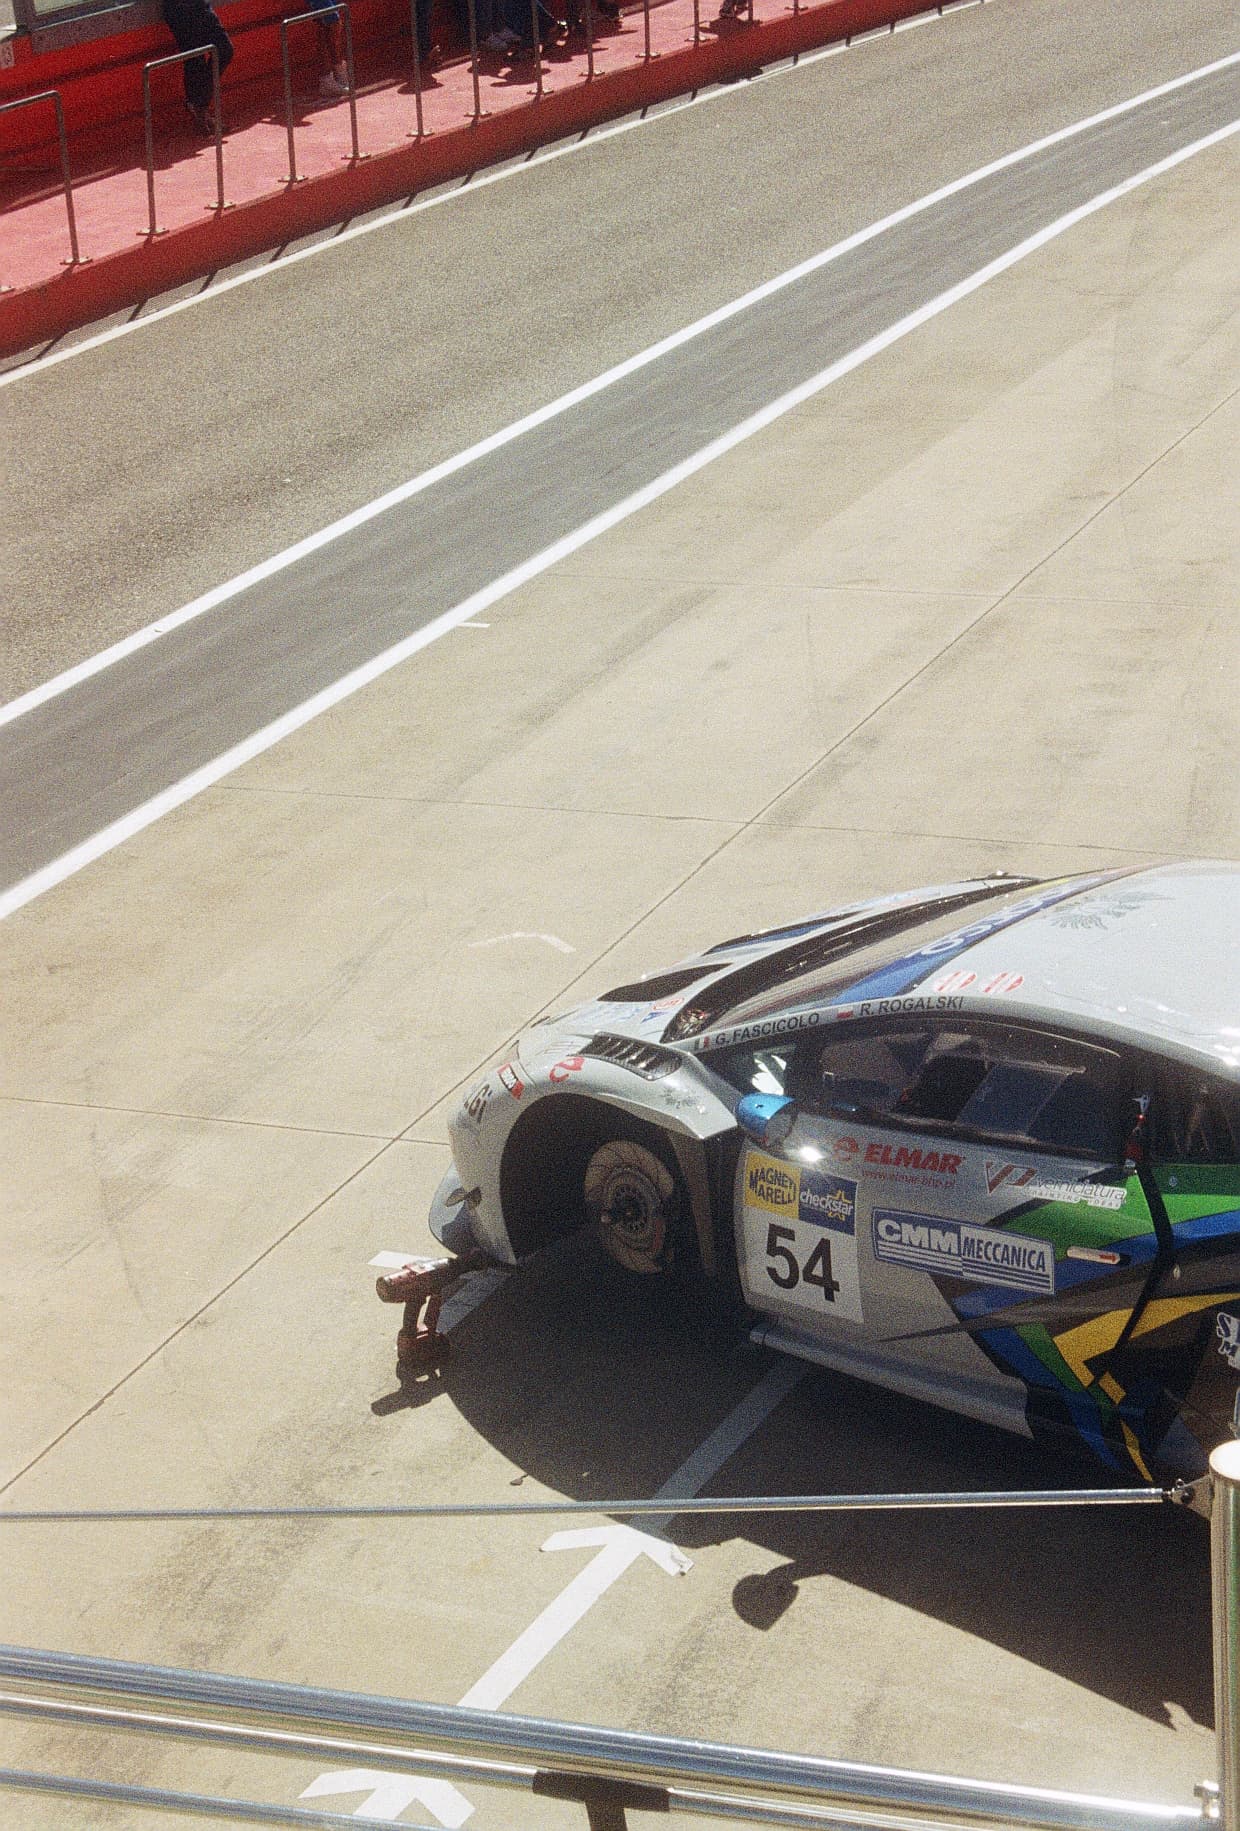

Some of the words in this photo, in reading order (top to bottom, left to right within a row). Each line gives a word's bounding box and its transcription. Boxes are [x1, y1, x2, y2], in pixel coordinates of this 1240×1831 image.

[860, 1002, 874, 1016] R.
[878, 996, 964, 1015] ROGALSKI
[715, 1032, 728, 1046] G.
[733, 1013, 819, 1043] FASCICOLO
[864, 1143, 963, 1174] ELMAR
[800, 1189, 854, 1216] checkstar
[877, 1218, 960, 1256] CMM
[963, 1235, 1047, 1273] MECCANICA
[766, 1222, 840, 1303] 54
